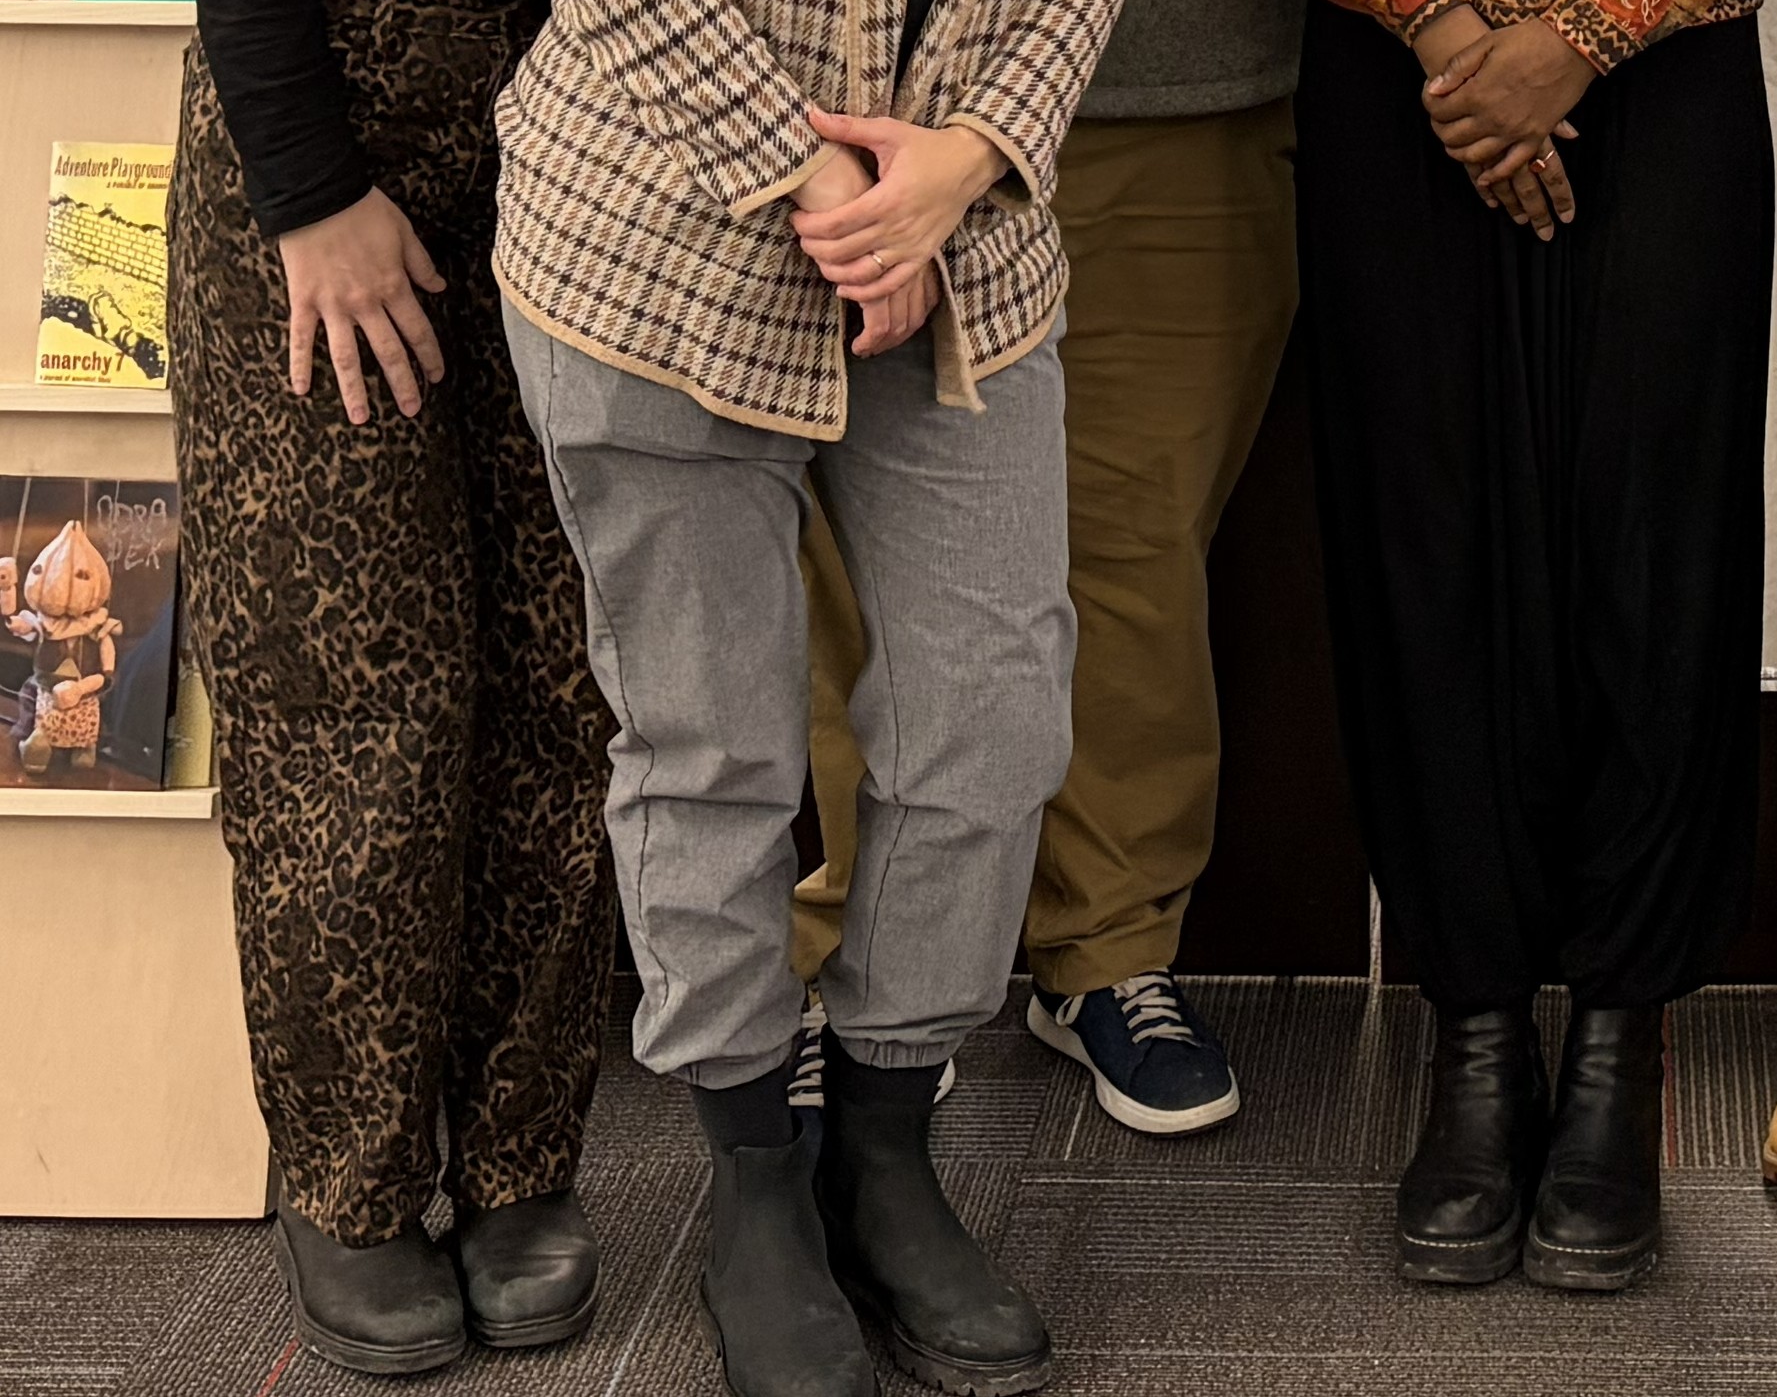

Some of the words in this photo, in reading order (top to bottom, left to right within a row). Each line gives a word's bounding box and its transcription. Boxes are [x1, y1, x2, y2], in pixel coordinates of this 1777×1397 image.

[54, 154, 110, 178] Adventure
[110, 156, 174, 188] Playground
[41, 350, 113, 376] anarchy
[115, 352, 126, 373] 7
